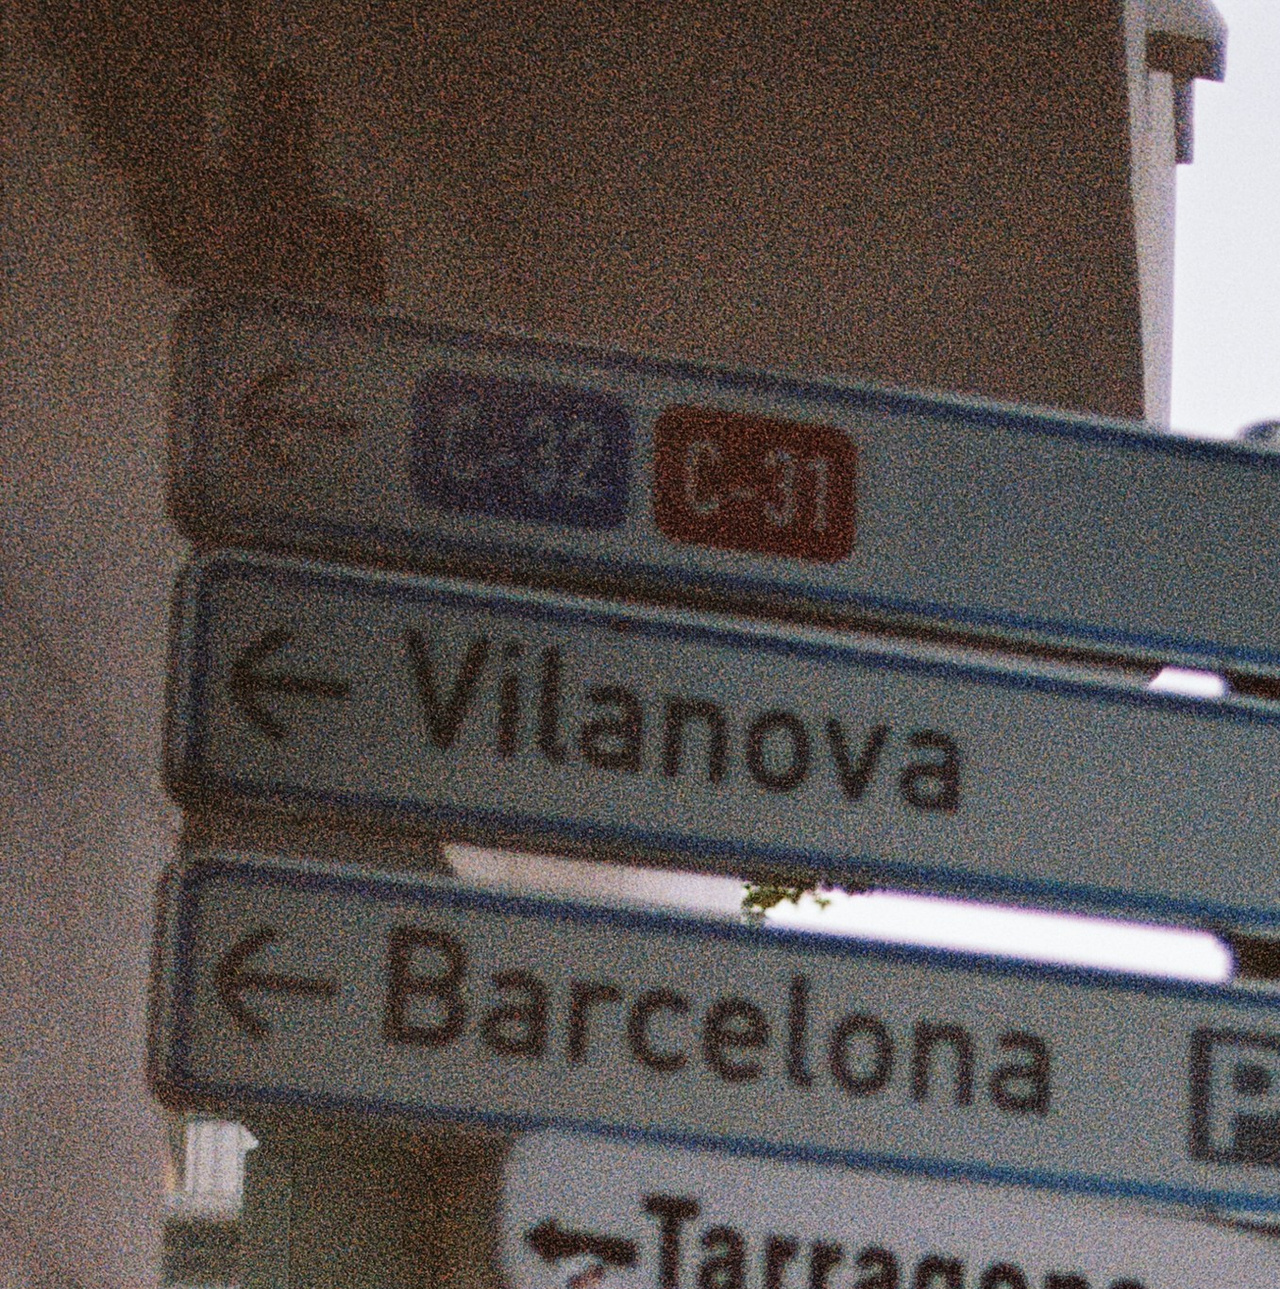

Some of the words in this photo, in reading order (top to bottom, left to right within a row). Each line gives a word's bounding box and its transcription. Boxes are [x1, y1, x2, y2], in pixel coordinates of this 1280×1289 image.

[442, 404, 606, 502] C-32
[682, 437, 832, 534] C-31
[408, 628, 963, 812] Vilanova
[385, 928, 1050, 1117] Barcelona
